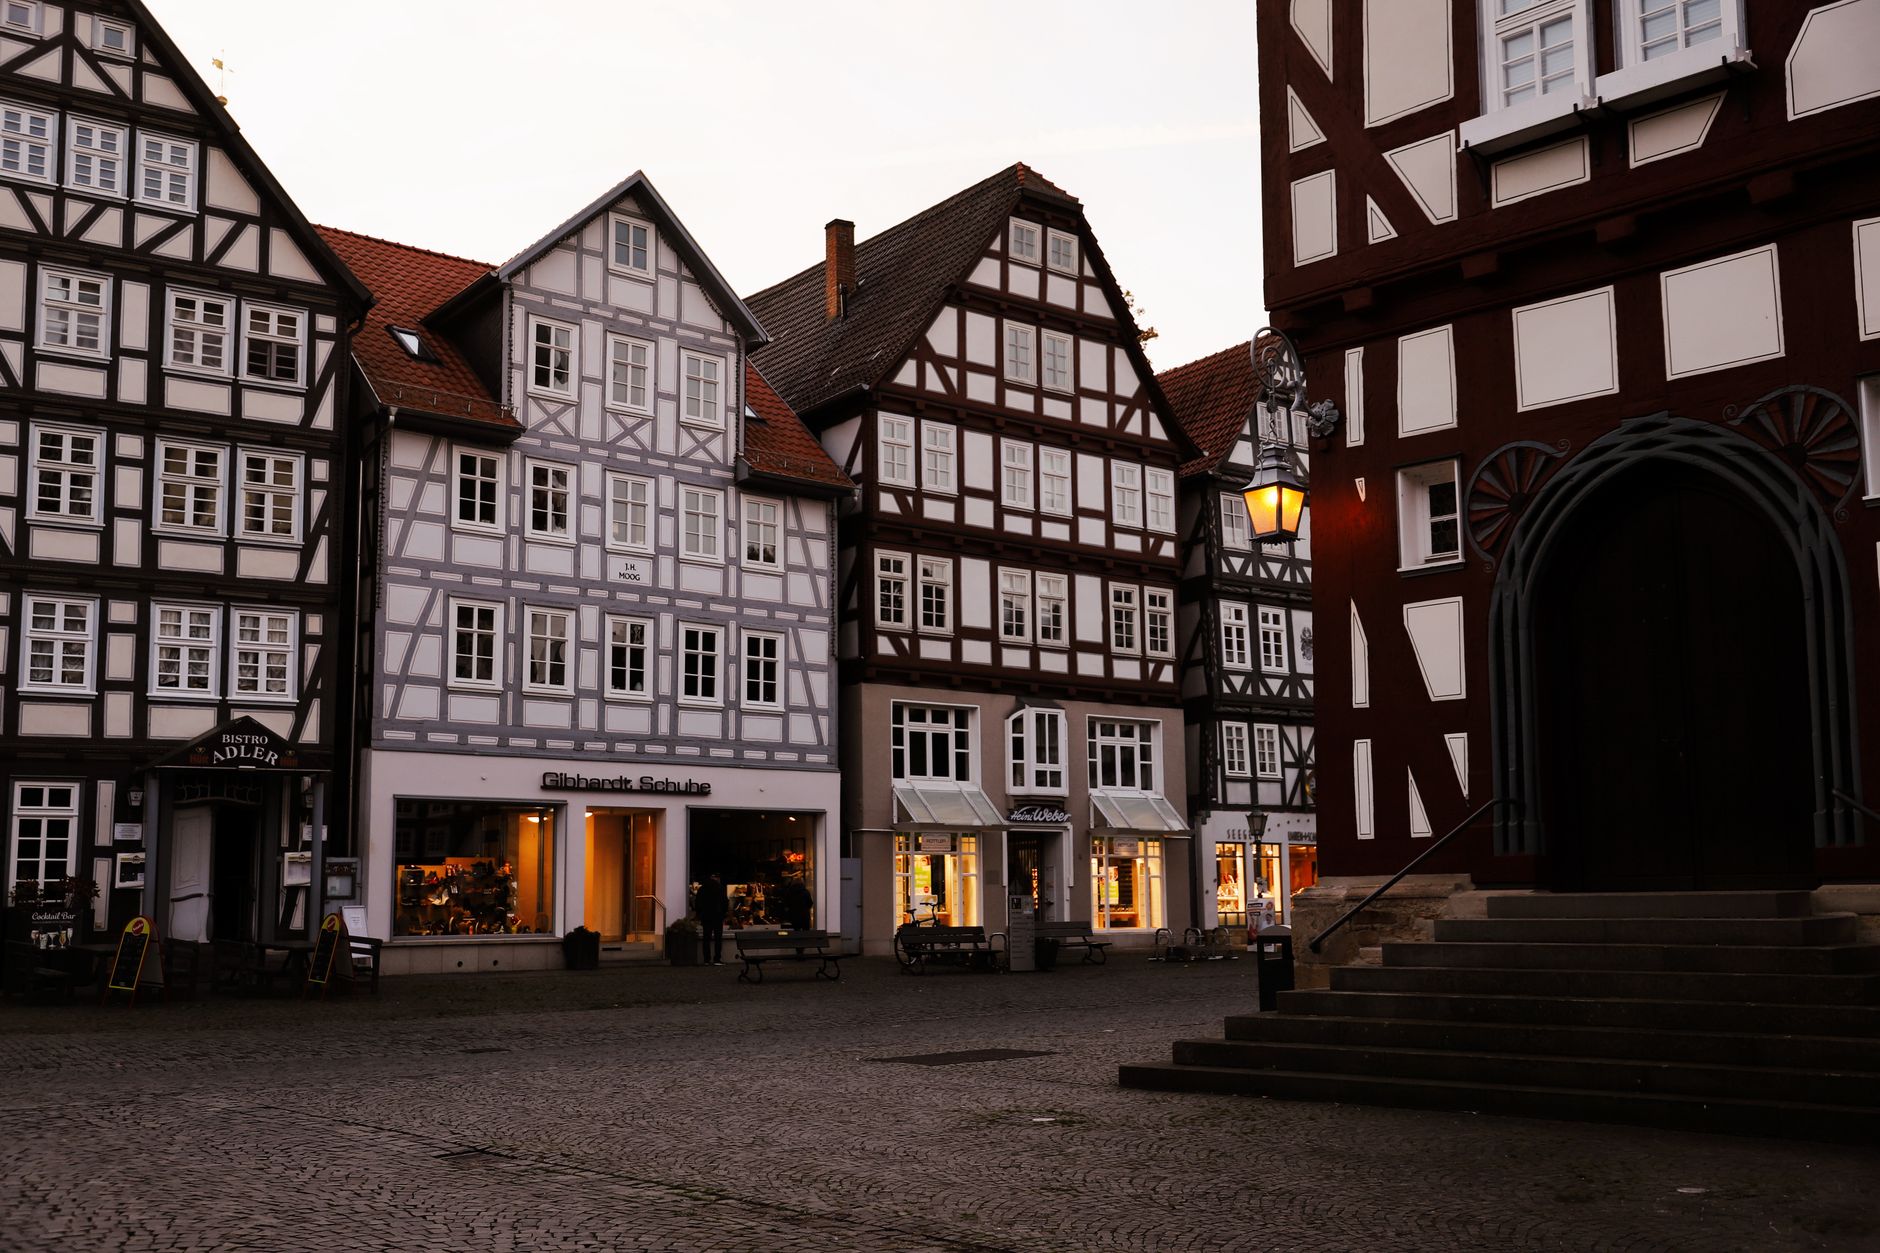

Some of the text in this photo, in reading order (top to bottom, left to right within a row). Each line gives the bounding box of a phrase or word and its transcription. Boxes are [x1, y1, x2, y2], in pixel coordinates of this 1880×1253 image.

[619, 572, 640, 581] MOOG
[222, 734, 268, 744] BISTRO
[212, 745, 279, 766] ADLER
[639, 776, 711, 793] Schuhe
[1031, 805, 1072, 822] Weber
[32, 912, 76, 920] Cocktail Bar
